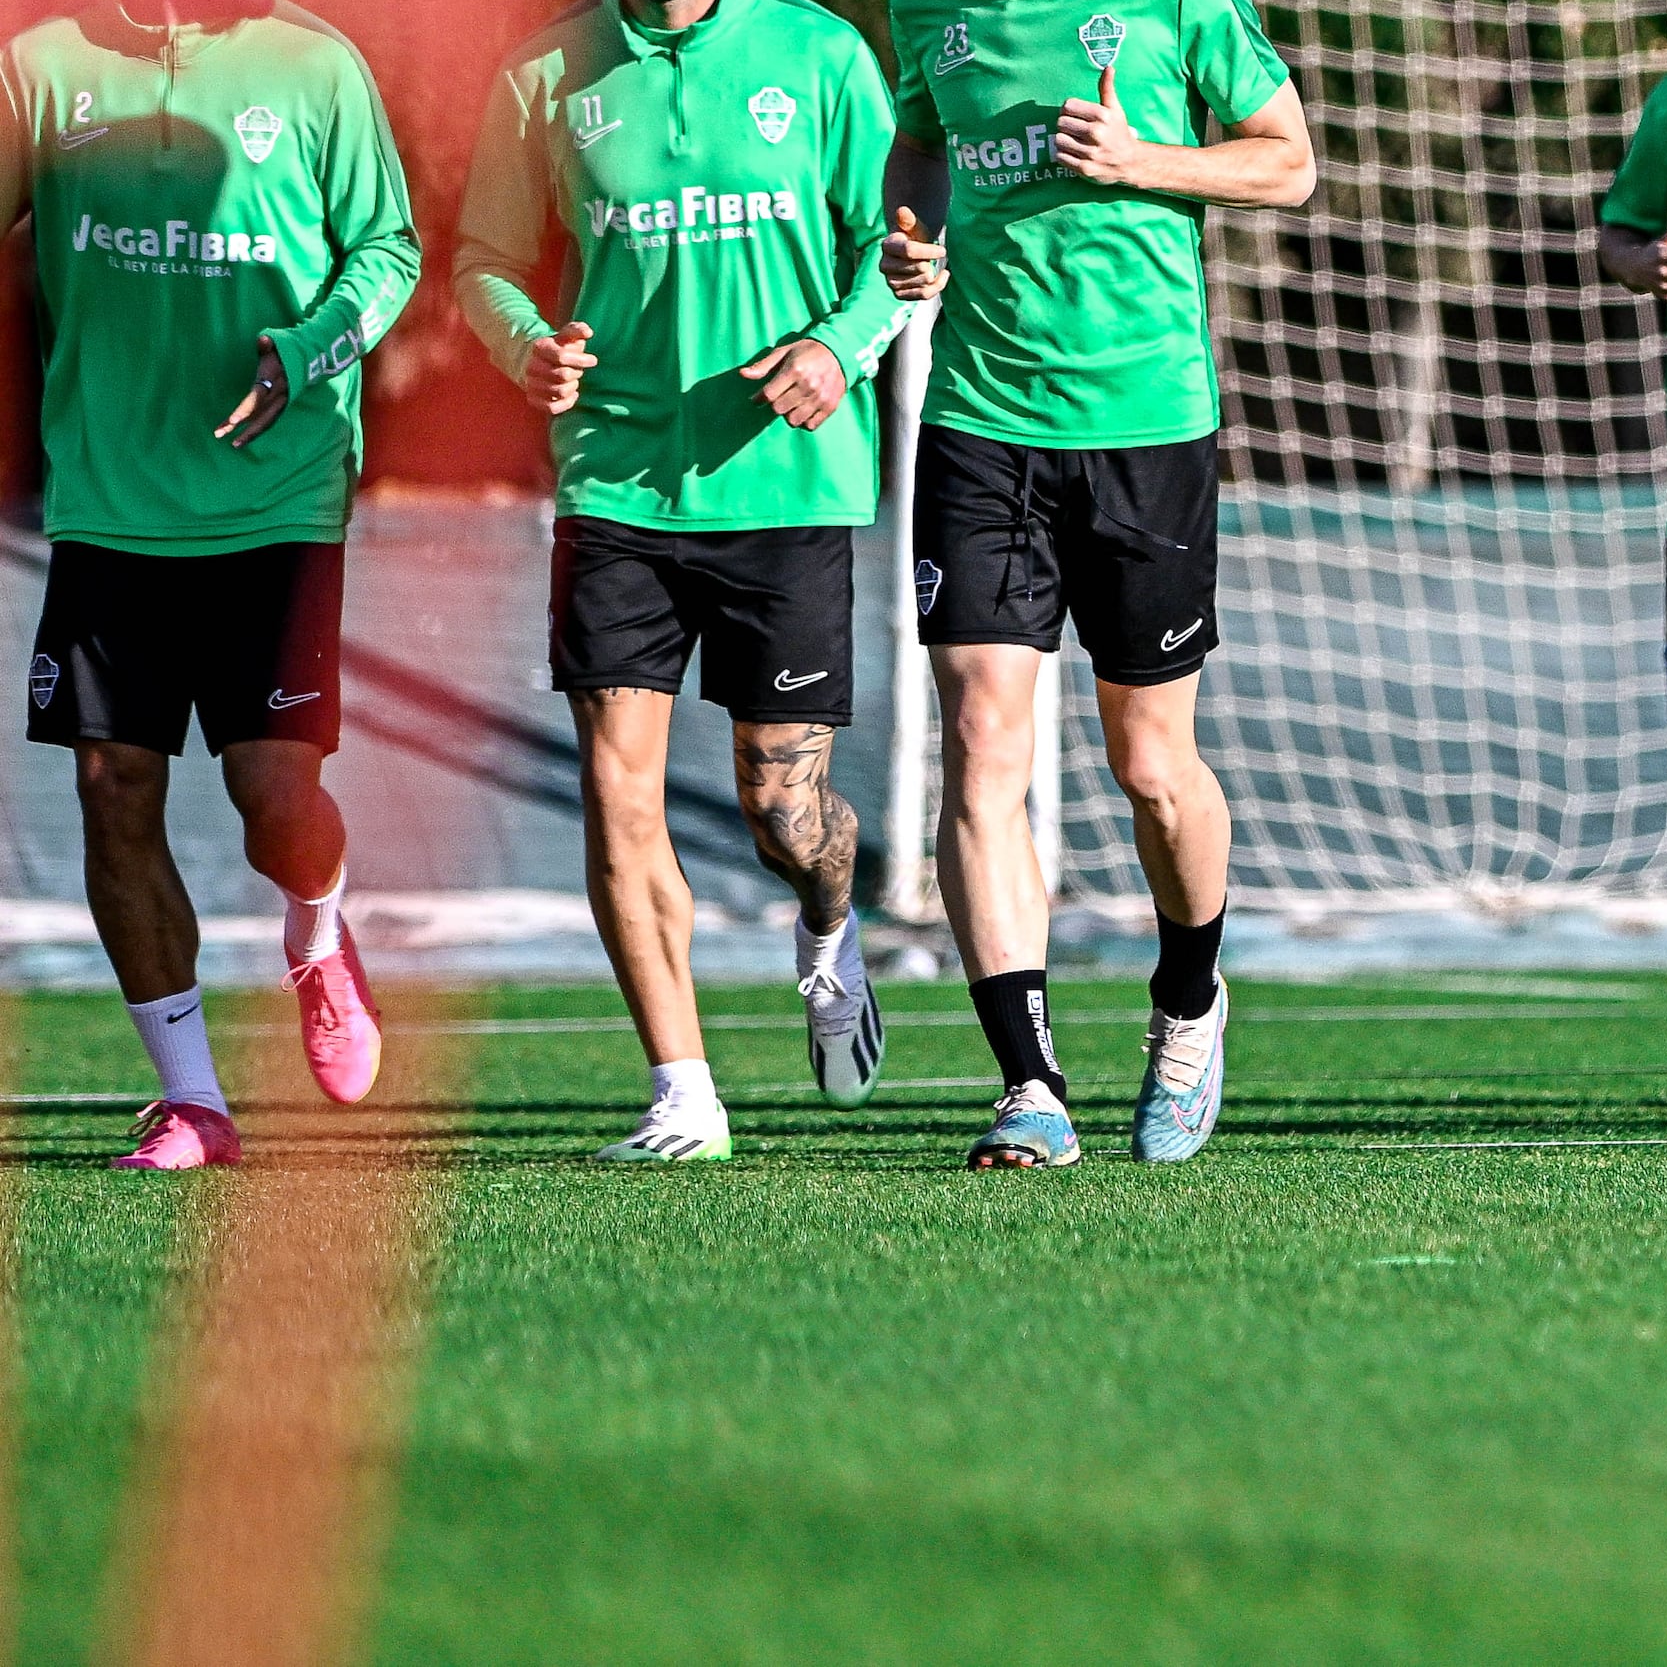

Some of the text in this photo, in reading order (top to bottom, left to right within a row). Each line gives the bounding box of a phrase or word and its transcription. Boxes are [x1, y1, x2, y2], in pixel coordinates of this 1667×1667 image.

[943, 23, 969, 56] 23
[75, 91, 93, 123] 2
[582, 94, 603, 127] 11
[974, 165, 1078, 187] EL REY DE LA FIB
[643, 234, 668, 249] REY
[691, 229, 709, 243] LA
[714, 226, 755, 241] FIBRA
[124, 259, 148, 274] REY
[171, 262, 189, 275] LA
